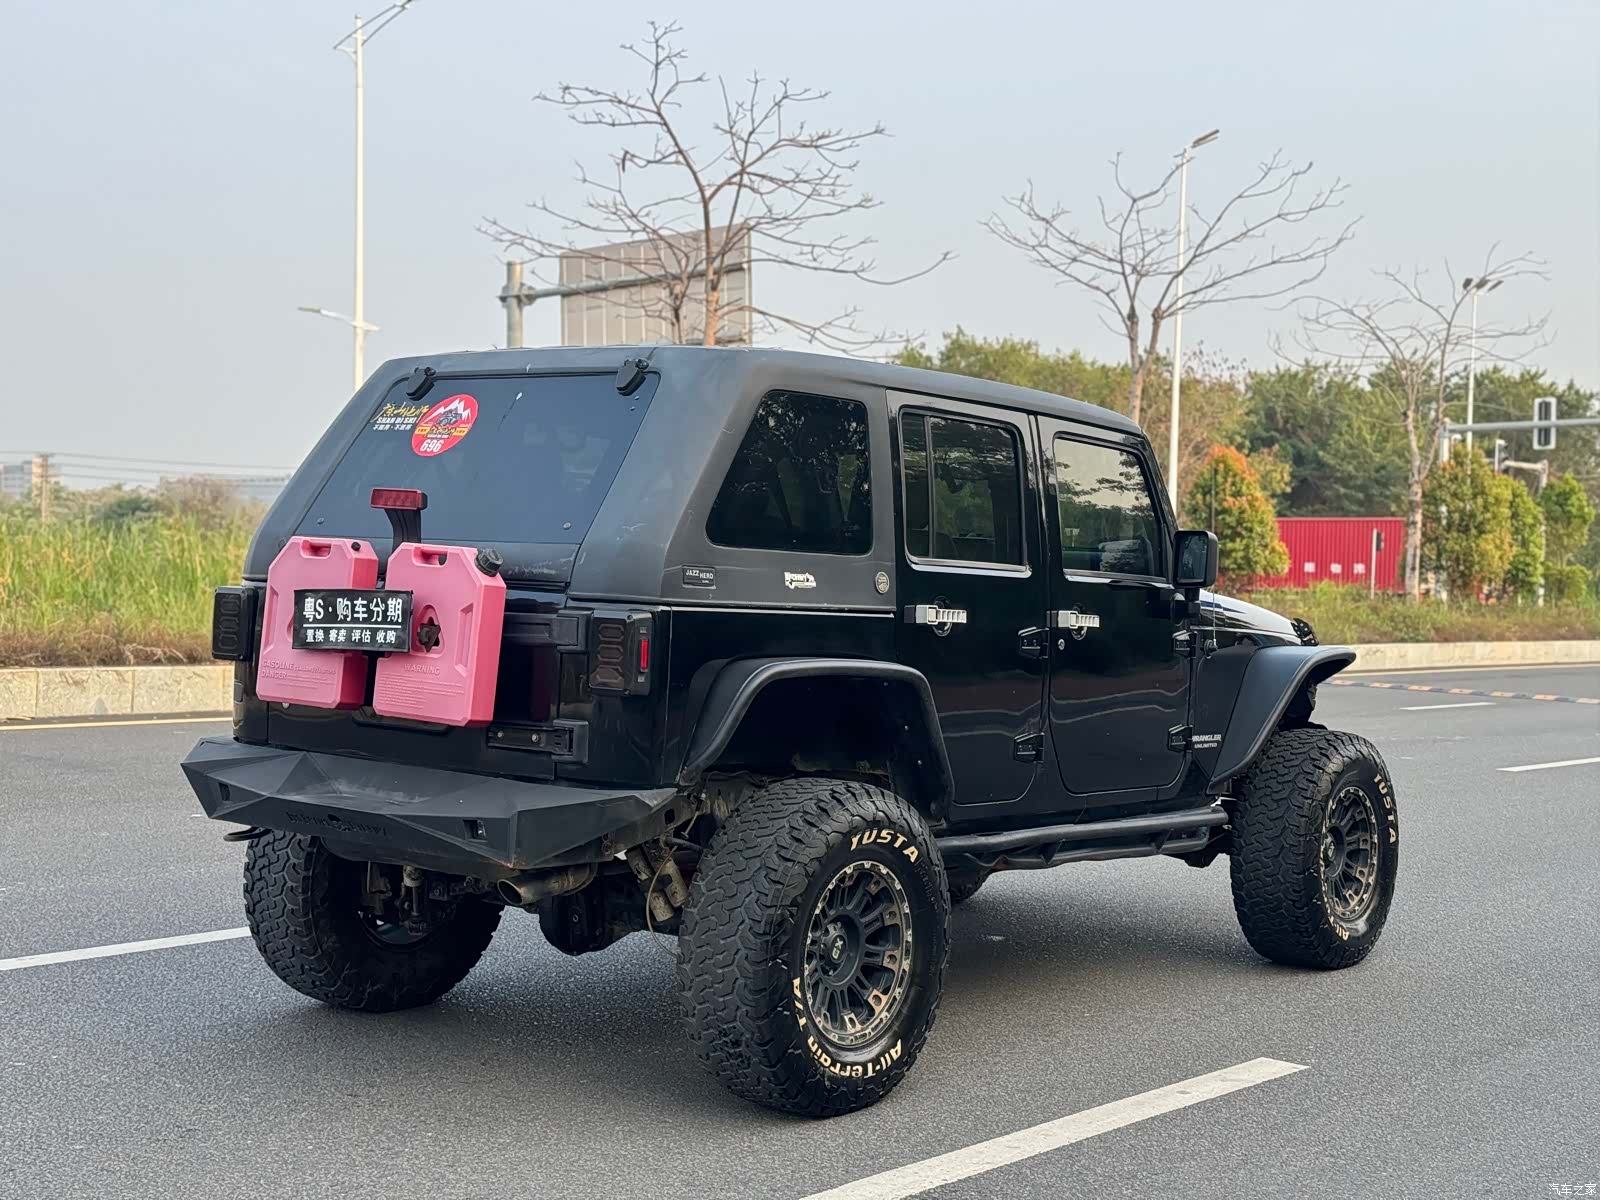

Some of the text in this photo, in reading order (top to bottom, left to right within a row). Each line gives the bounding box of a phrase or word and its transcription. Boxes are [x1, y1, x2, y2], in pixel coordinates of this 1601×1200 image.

[420, 439, 444, 453] 696
[306, 629, 396, 644] 置换 寄卖 评估 收购
[262, 659, 294, 671] GASOLINE
[403, 663, 441, 676] WARNING
[261, 669, 287, 680] DANGER
[1191, 734, 1222, 742] WRANGLER
[1374, 773, 1397, 844] YUSTA
[850, 828, 919, 864] YUSTA
[807, 1035, 902, 1080] All-Terrain
